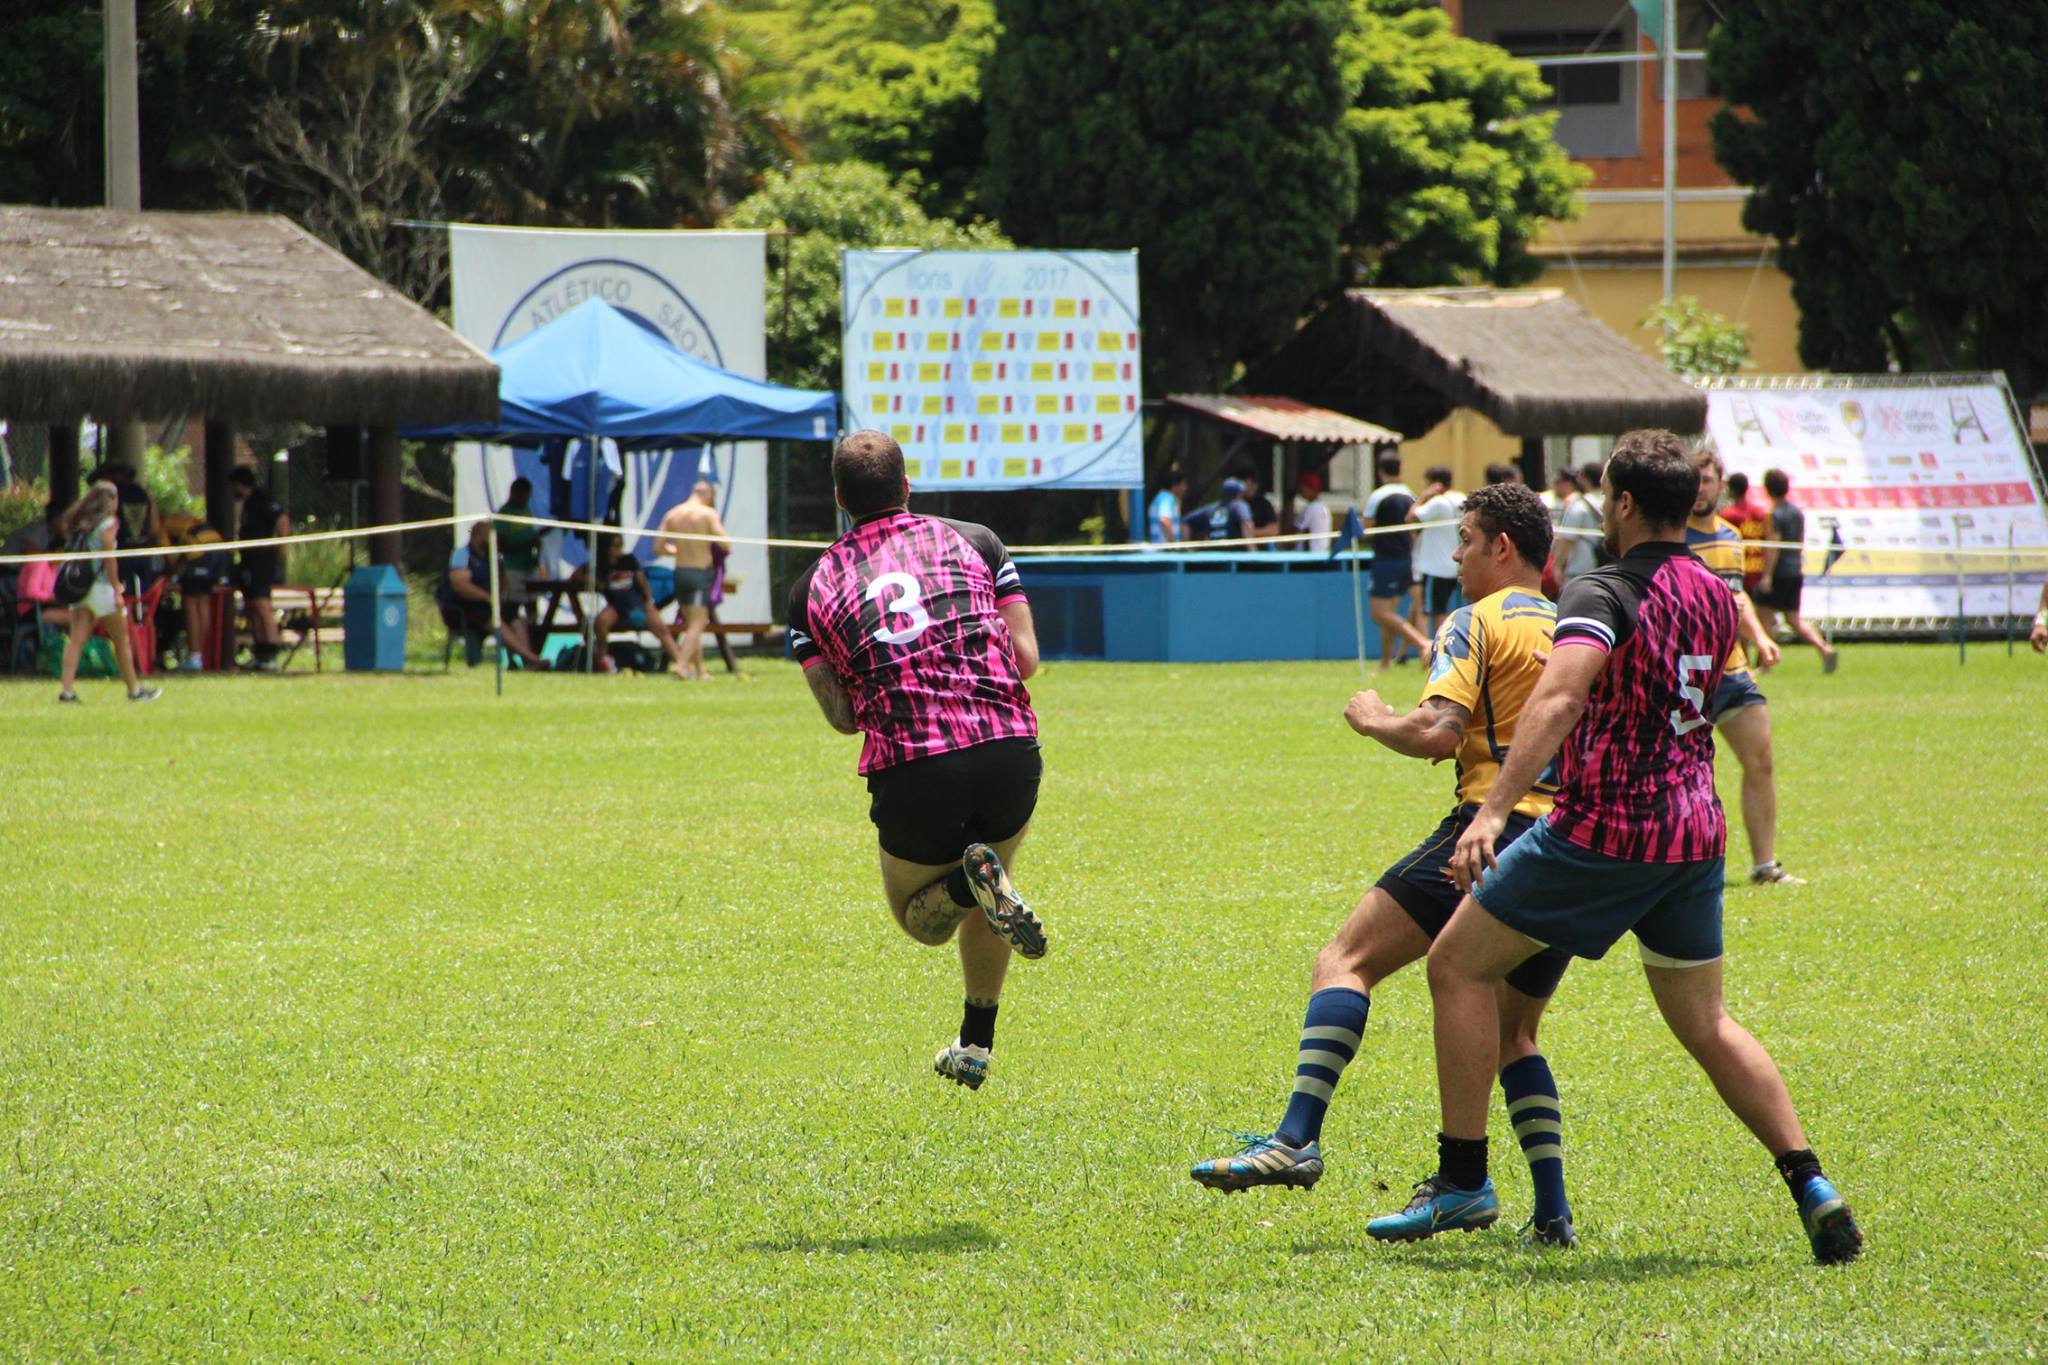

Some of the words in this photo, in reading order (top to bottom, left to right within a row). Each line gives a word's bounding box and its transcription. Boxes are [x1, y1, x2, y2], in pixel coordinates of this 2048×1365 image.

[1023, 264, 1071, 291] 2017
[865, 571, 929, 645] 3
[1670, 654, 1714, 736] 5
[958, 1061, 987, 1076] Reebo
